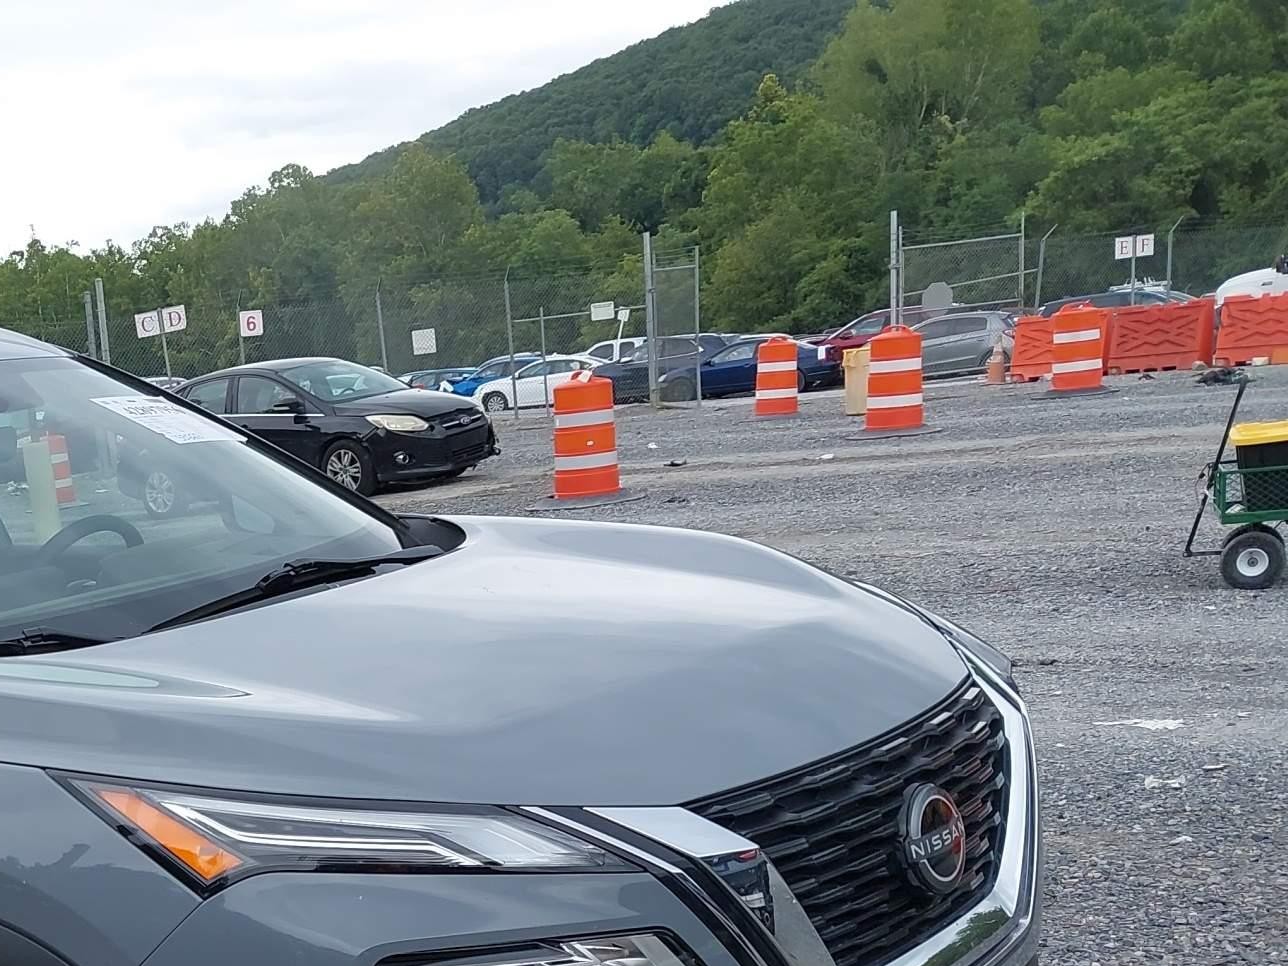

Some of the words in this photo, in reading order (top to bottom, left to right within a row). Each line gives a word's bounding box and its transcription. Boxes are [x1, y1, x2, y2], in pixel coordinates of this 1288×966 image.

[1120, 240, 1129, 255] E
[1141, 238, 1150, 253] F
[141, 316, 155, 333] C
[168, 311, 182, 327] D
[246, 315, 257, 332] 6
[910, 819, 965, 859] NISSAN
